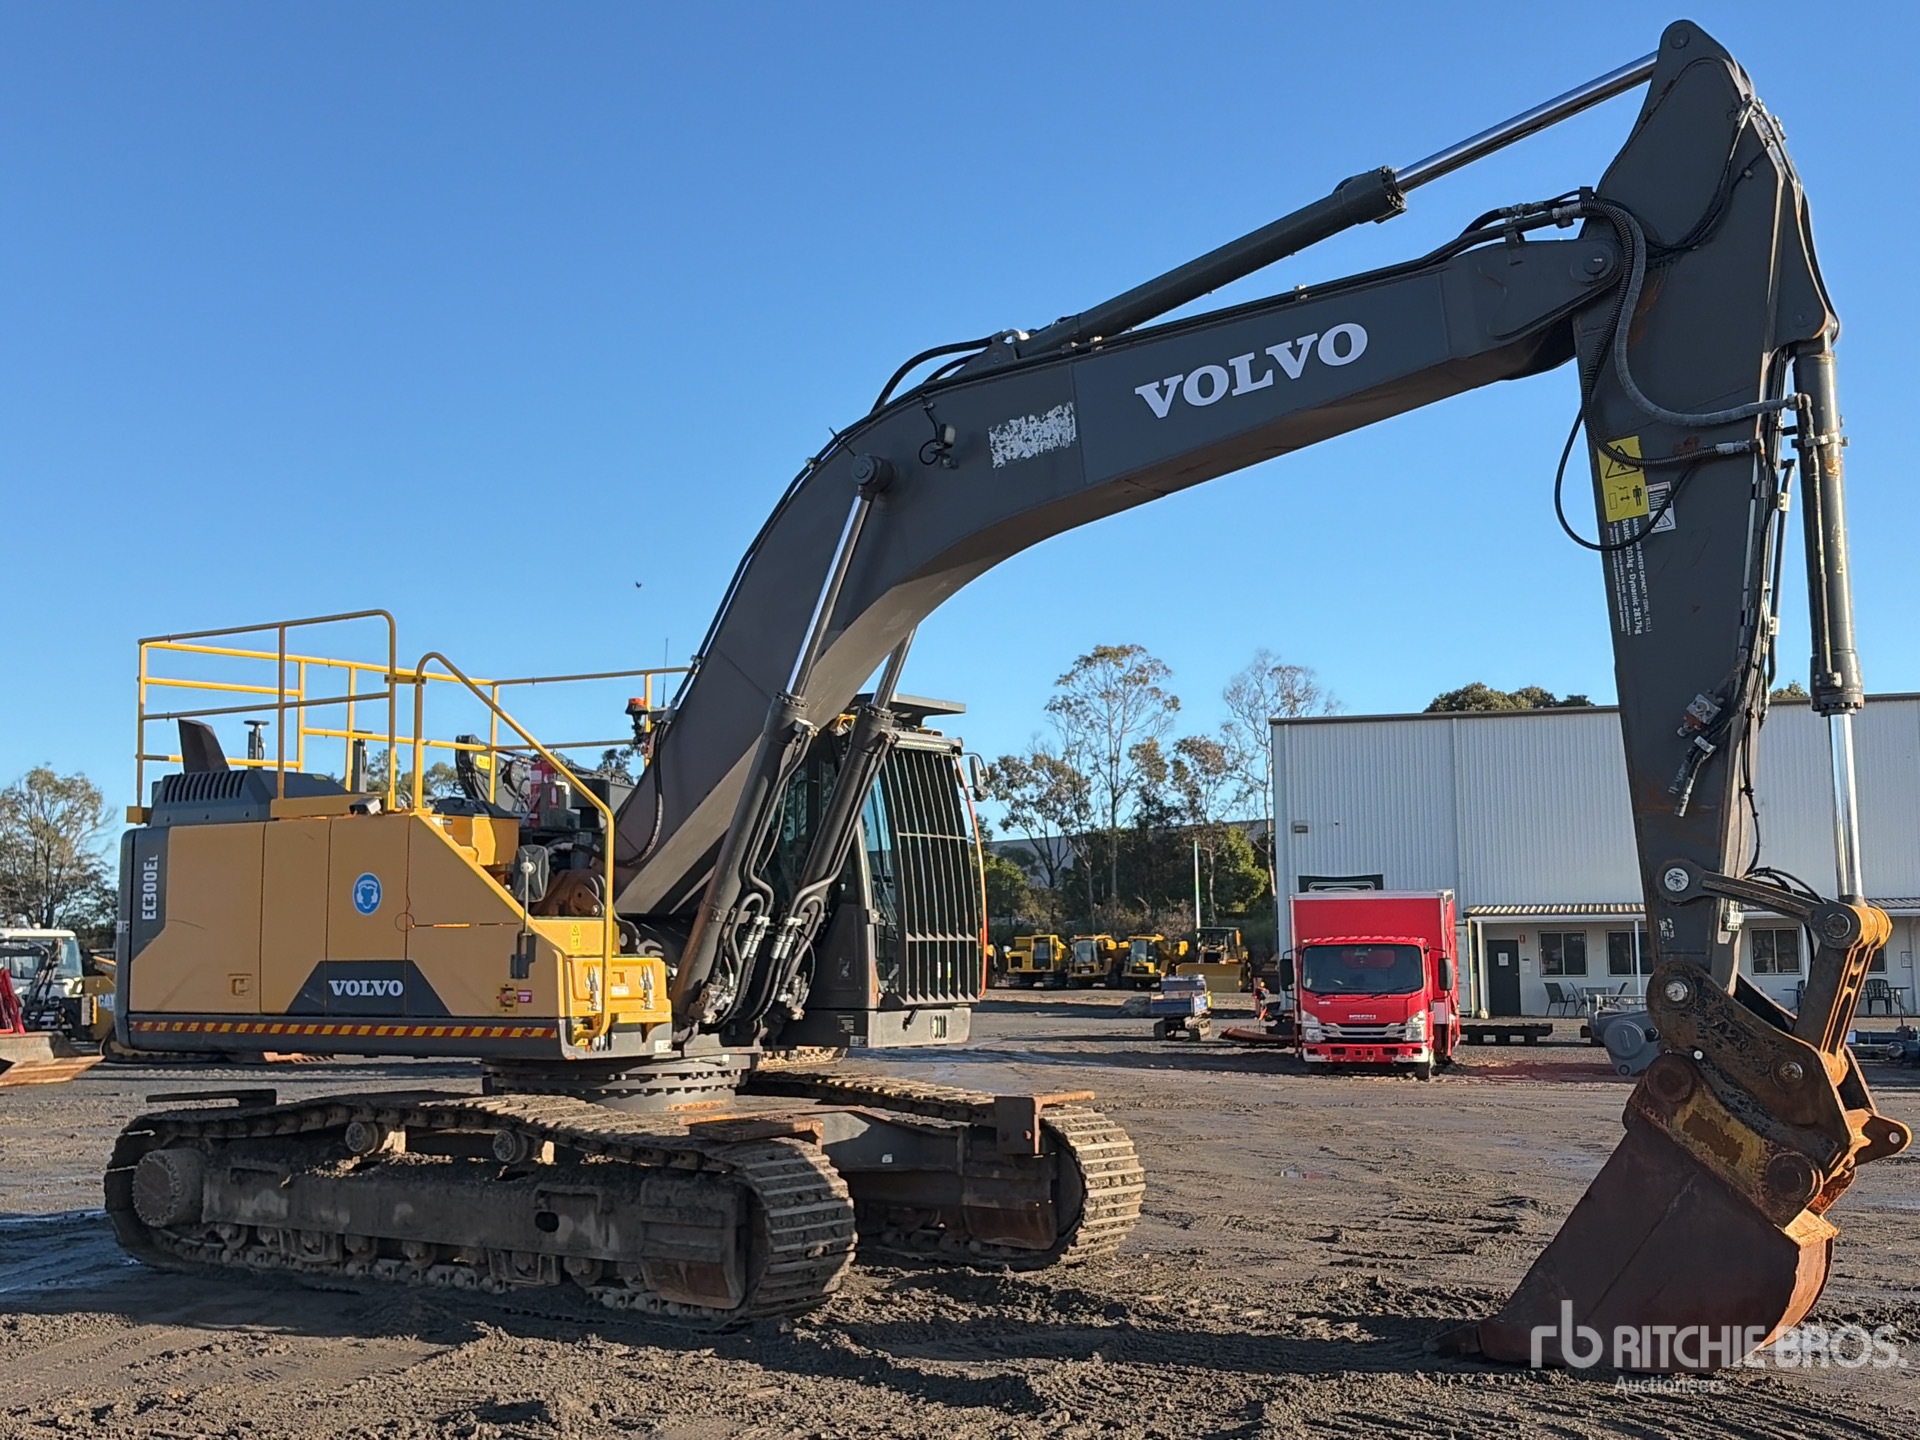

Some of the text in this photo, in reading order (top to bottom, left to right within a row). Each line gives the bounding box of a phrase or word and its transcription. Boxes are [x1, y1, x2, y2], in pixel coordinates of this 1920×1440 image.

[1134, 323, 1368, 419] VOLVO
[1622, 519, 1631, 540] Static
[1625, 545, 1635, 568] 201kg
[1628, 573, 1641, 607] Dynamic
[1632, 607, 1643, 635] 2817kg
[328, 980, 404, 997] VOLVO
